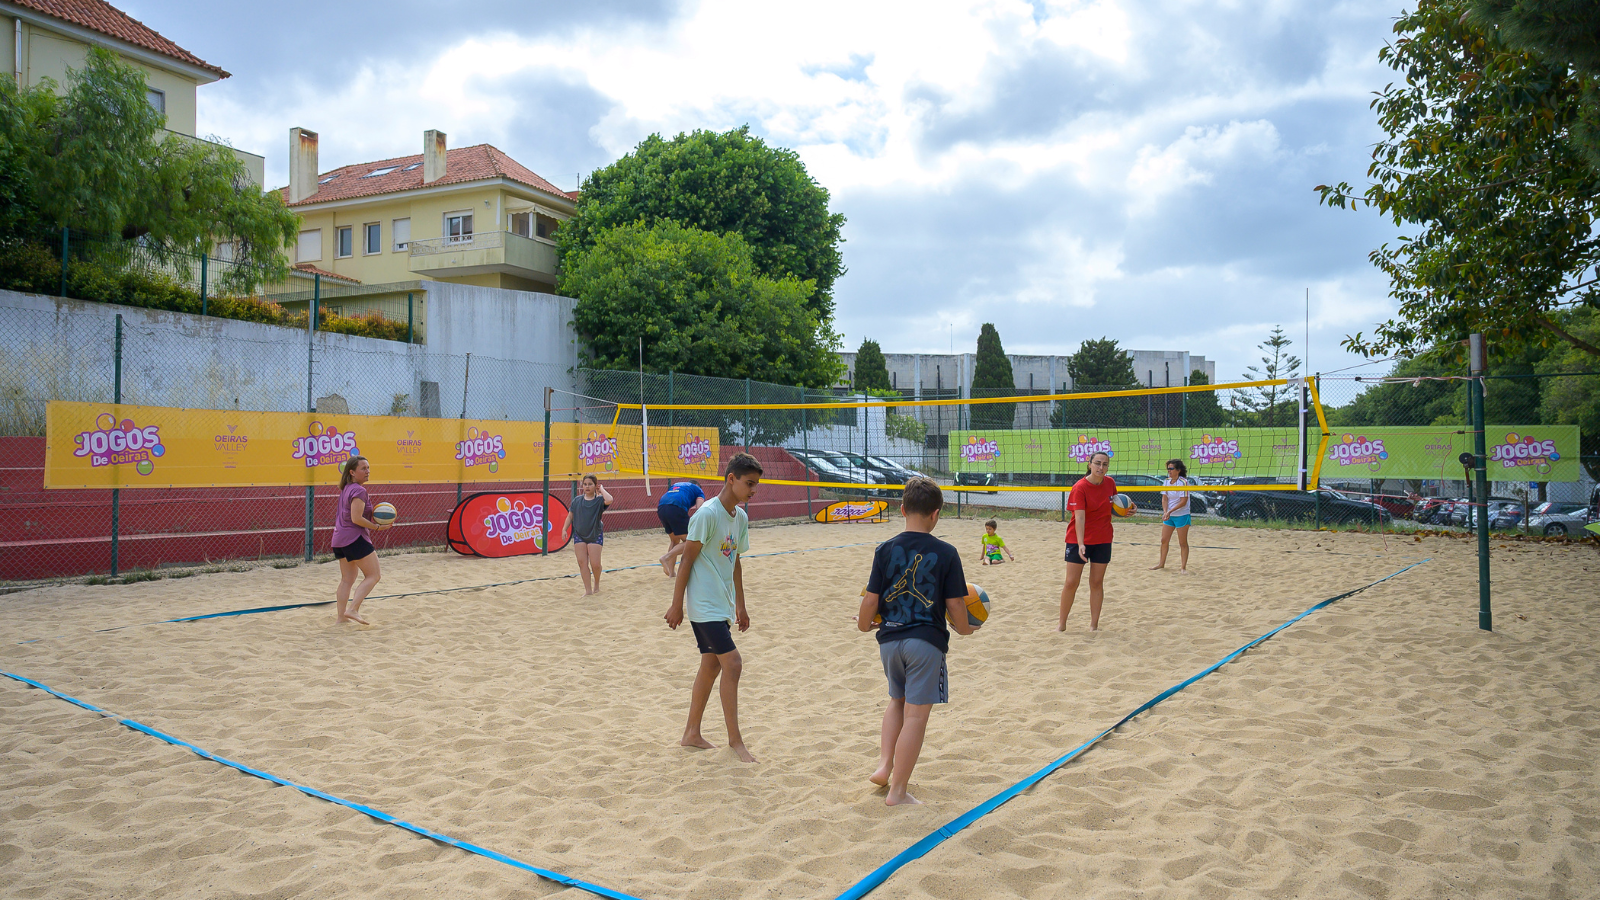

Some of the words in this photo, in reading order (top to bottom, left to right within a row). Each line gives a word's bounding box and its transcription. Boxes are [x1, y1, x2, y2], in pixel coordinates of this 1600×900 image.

[74, 426, 160, 456] JOGOS
[214, 435, 248, 443] OEIRAS
[214, 443, 248, 451] VALLEY
[292, 432, 356, 458] JOGOS
[455, 436, 502, 459] JOGOS
[678, 439, 710, 459] JOGOS
[960, 441, 998, 457] JOGOS
[1069, 440, 1111, 458] JOGOS
[1190, 440, 1238, 459] JOGOS
[1329, 440, 1384, 460] JOGOS
[1490, 440, 1555, 460] JOGOS
[93, 455, 108, 466] De
[111, 452, 147, 464] Oeiras
[306, 457, 318, 466] De
[320, 454, 347, 464] Oeiras
[1351, 456, 1376, 464] Oeiras
[488, 506, 544, 537] JOGOS
[502, 535, 513, 544] De
[514, 528, 540, 540] Oeiras
